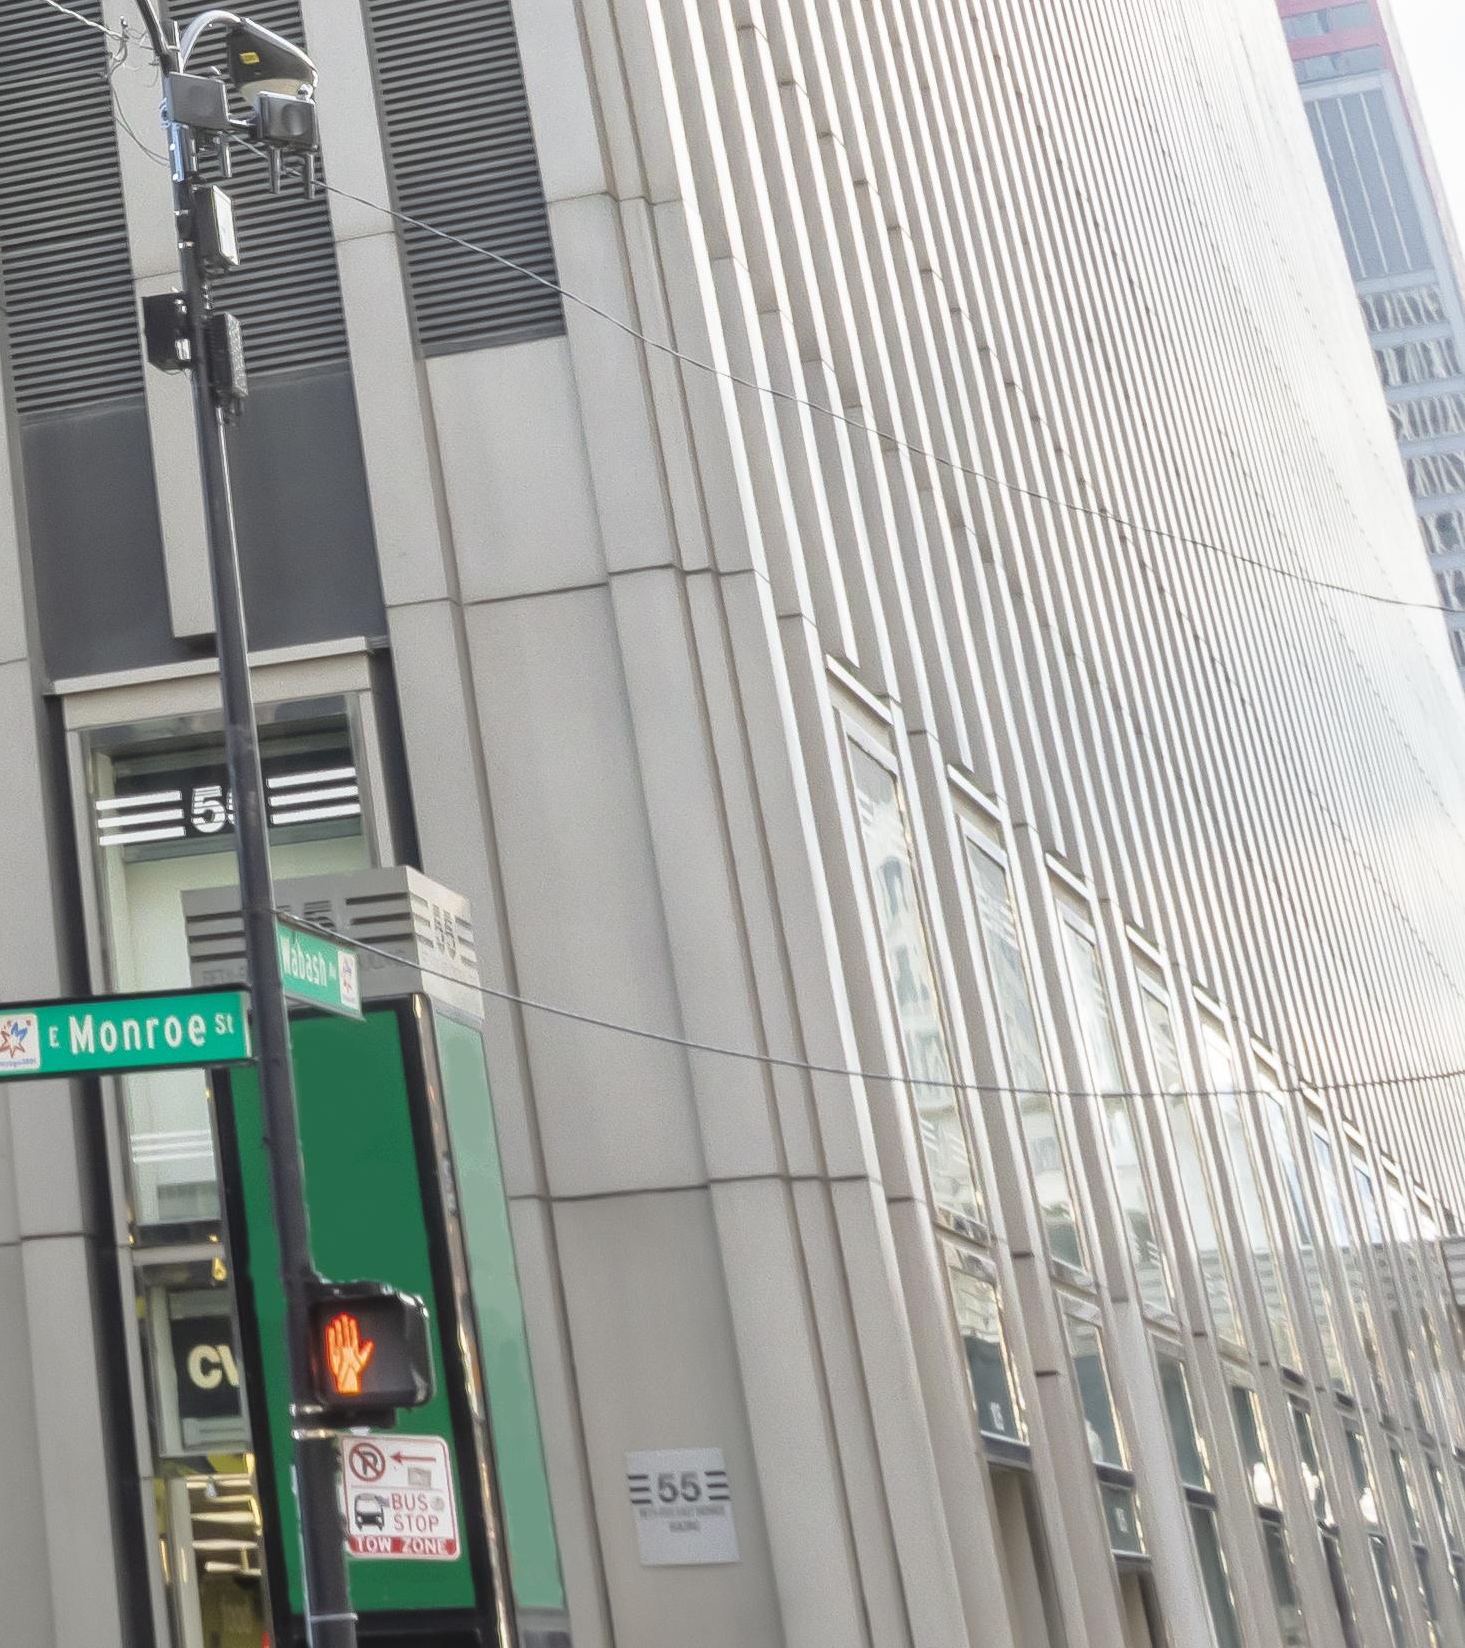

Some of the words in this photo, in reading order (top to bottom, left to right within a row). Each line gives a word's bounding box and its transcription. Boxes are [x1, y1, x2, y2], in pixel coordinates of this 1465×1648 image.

[191, 785, 236, 834] 5
[279, 933, 328, 988] Wabash
[48, 1025, 61, 1049] E
[69, 1013, 208, 1055] Monroe
[214, 1012, 235, 1036] St
[390, 1492, 429, 1512] BUS
[656, 1471, 702, 1503] 55
[392, 1512, 440, 1533] STOP
[356, 1536, 391, 1554] TOW
[402, 1537, 445, 1555] ZONE
